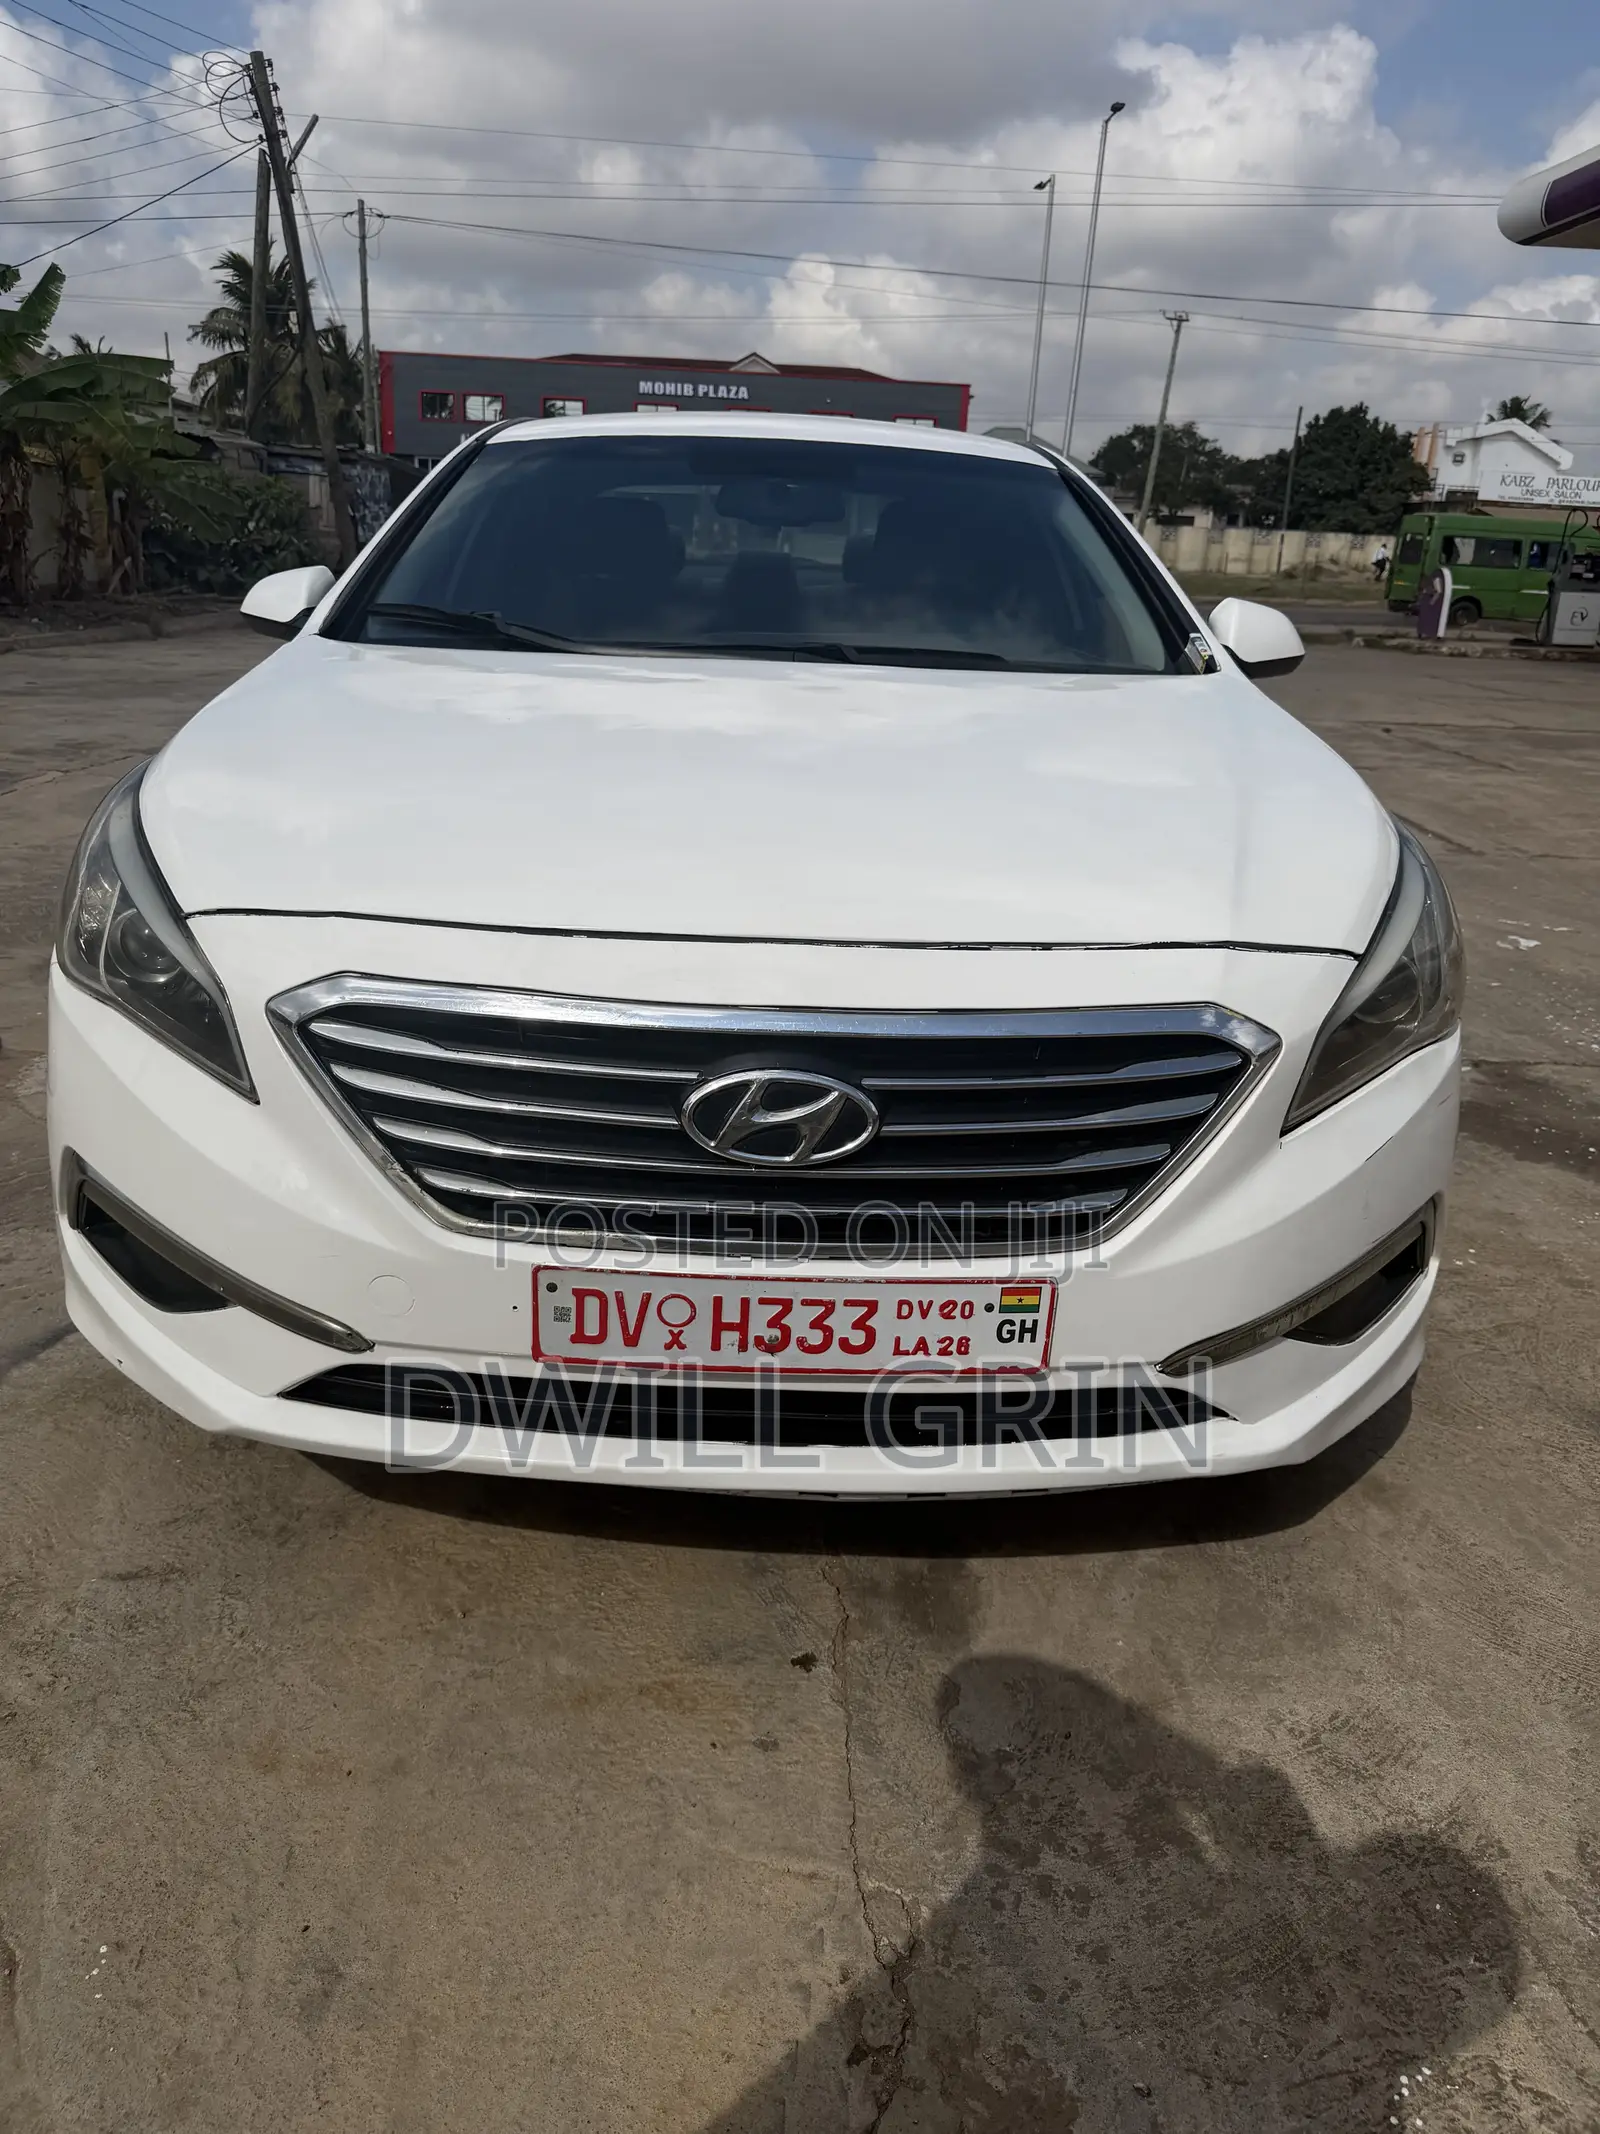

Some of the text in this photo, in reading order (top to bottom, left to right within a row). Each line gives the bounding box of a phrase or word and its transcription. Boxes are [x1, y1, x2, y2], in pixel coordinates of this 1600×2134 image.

[639, 381, 749, 399] MOHIB PLAZA
[1499, 475, 1535, 488] KABZ
[1520, 489, 1551, 498] UNISEX
[1554, 490, 1582, 500] SALON
[710, 1295, 878, 1355] H333
[996, 1319, 1039, 1344] GH
